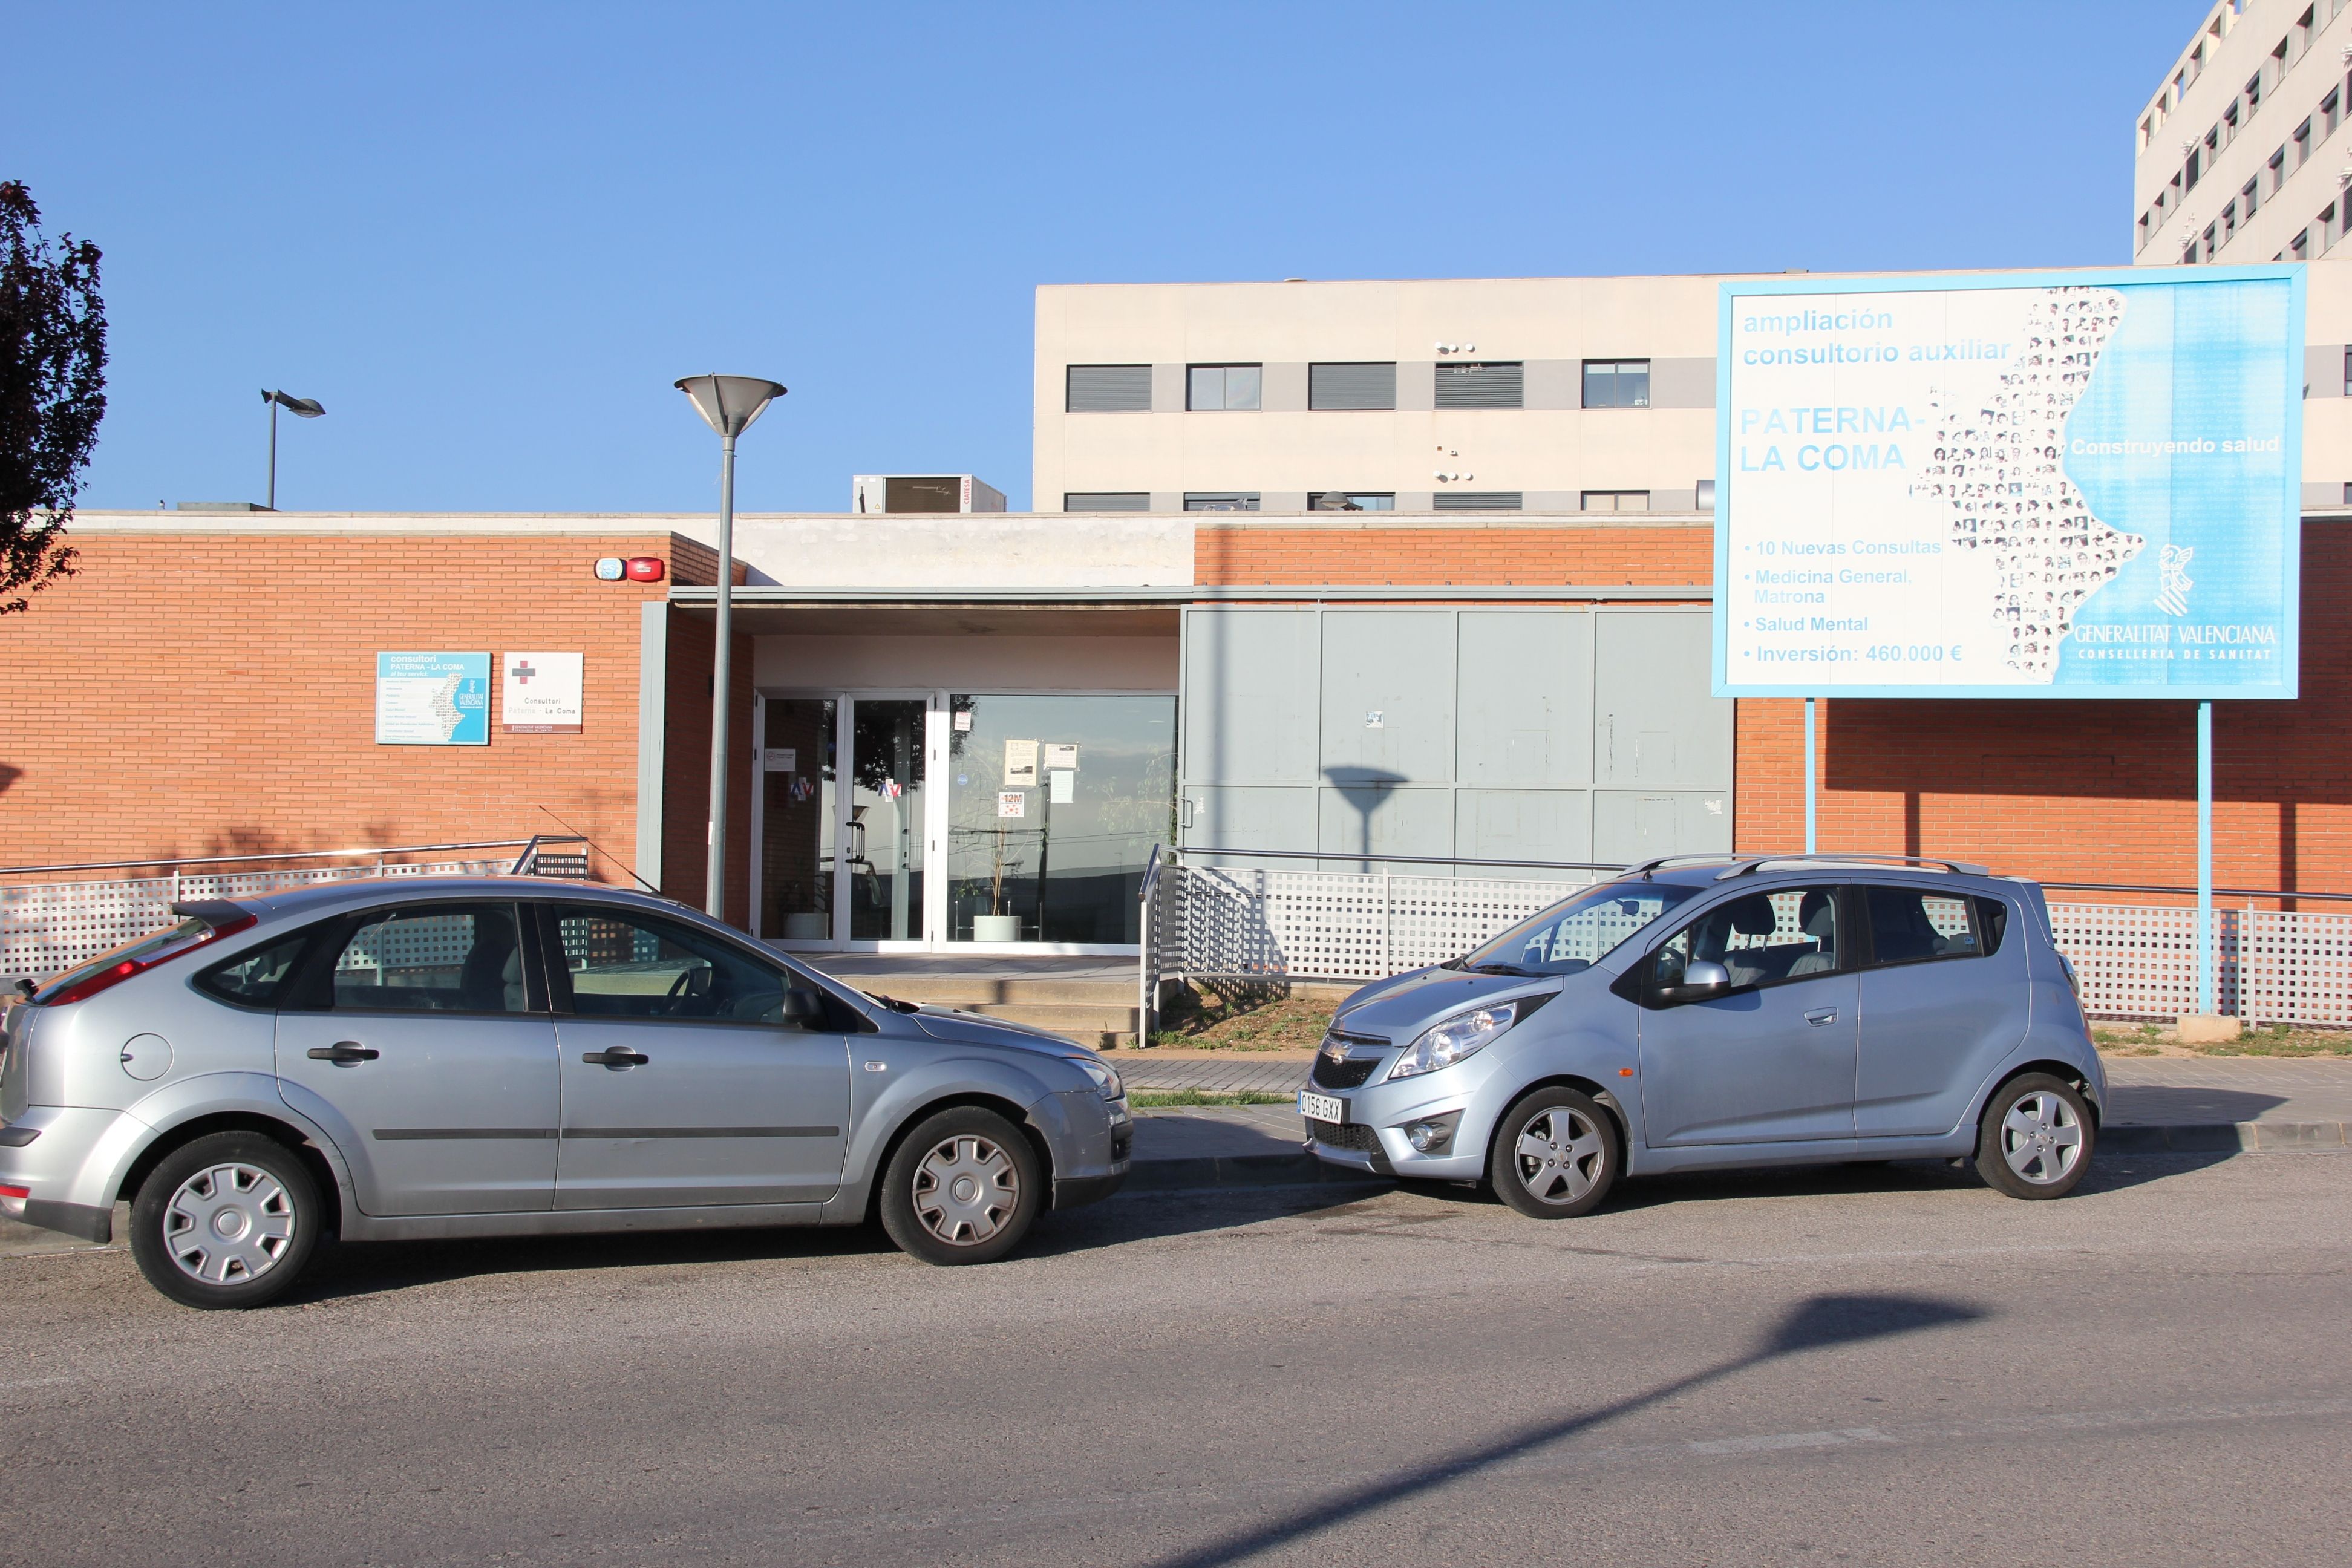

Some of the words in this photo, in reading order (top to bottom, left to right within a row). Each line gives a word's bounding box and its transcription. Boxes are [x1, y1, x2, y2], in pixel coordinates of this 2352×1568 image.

[1743, 308, 1893, 336] ampliación
[1743, 341, 1899, 365] consultorio
[1909, 339, 2012, 361] auxiliar
[1741, 406, 1926, 434] PATERNA-
[2071, 437, 2216, 458] Construyendo
[2221, 436, 2279, 452] salud
[1741, 445, 1786, 471] LA
[1797, 443, 1906, 471] COMA
[1756, 541, 1775, 555] 10
[1782, 540, 1846, 555] Nuevas
[1852, 539, 1942, 554] Consultas
[1755, 569, 1833, 584] Medicina
[1838, 569, 1912, 585] General,
[1754, 589, 1825, 603] Matrona
[1756, 616, 1805, 631] Salud
[1810, 616, 1869, 631] Mental
[2074, 624, 2172, 643] GENERALITAT
[2178, 625, 2276, 644] VALENCIANA
[390, 655, 436, 663] consultori
[1757, 645, 1858, 661] Inversión:
[1866, 645, 1943, 661] 460.000
[1949, 645, 1962, 661] €
[2078, 648, 2175, 660] CONSELLERIA
[2184, 648, 2201, 659] DE
[2209, 648, 2271, 659] SANITAT
[1302, 1094, 1321, 1116] 0156
[1323, 1099, 1340, 1121] GXX
